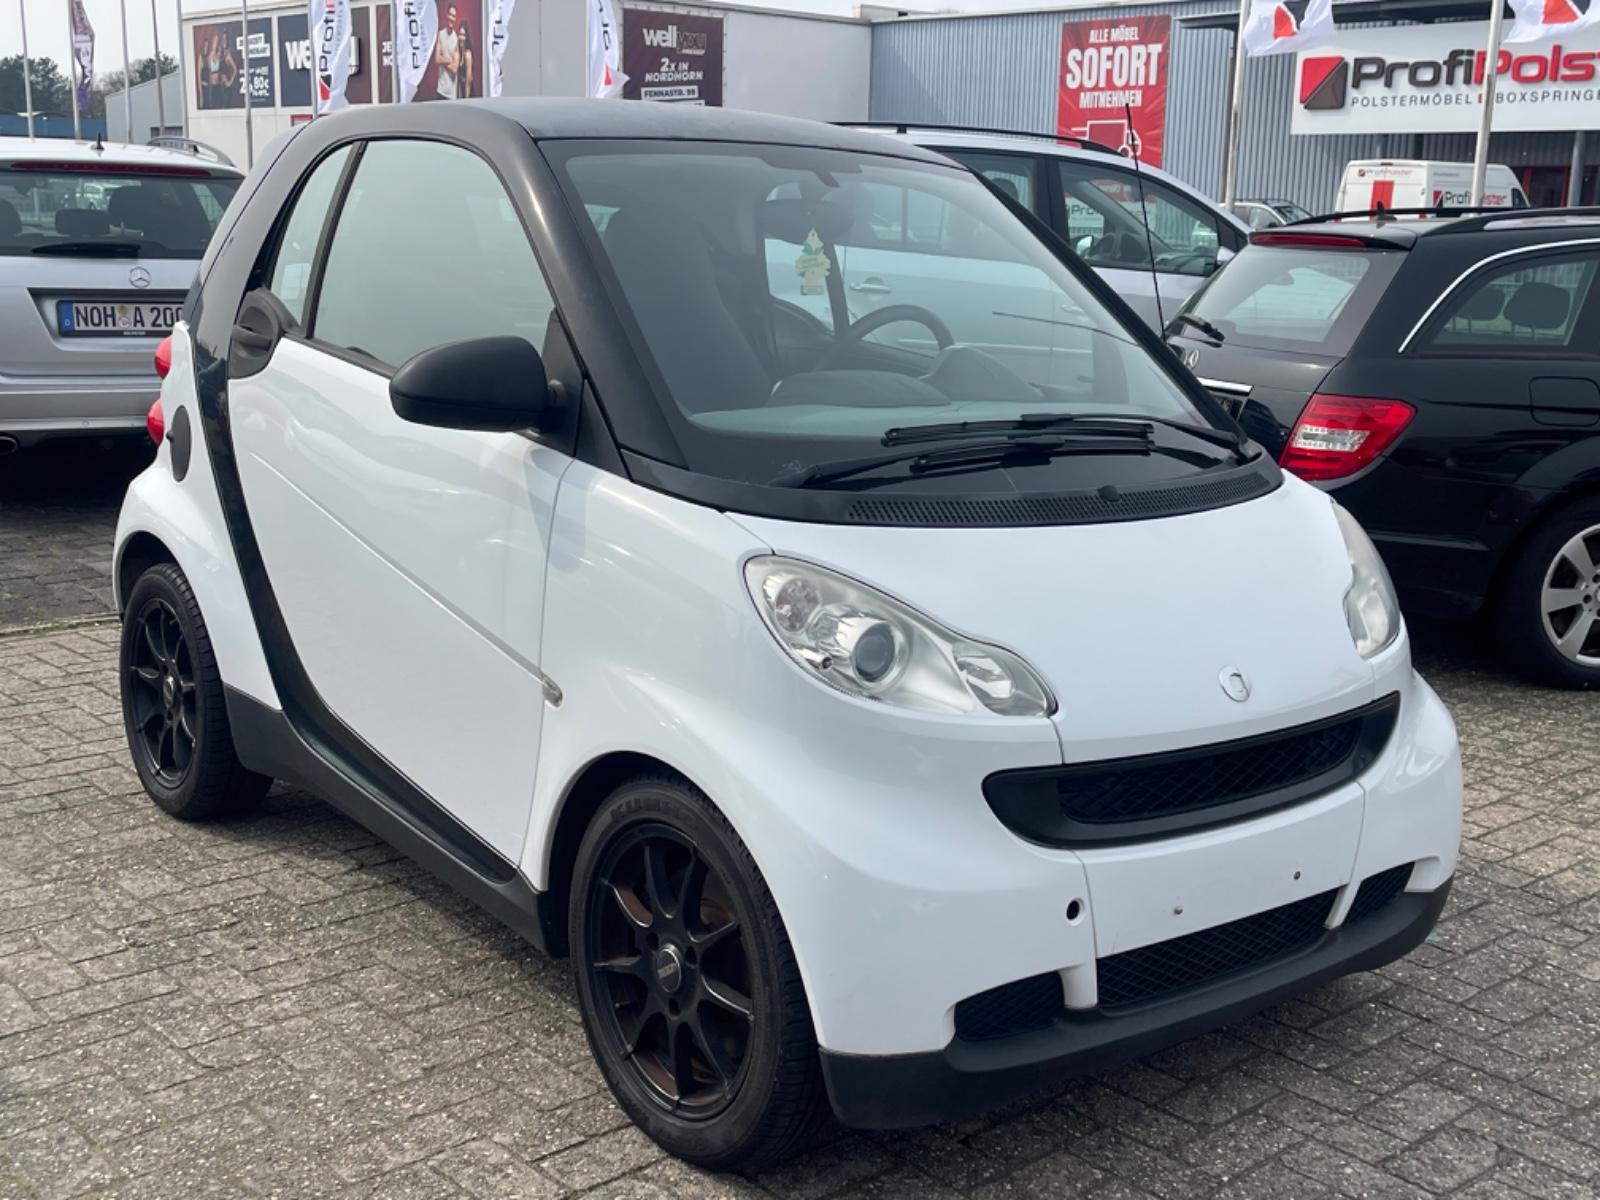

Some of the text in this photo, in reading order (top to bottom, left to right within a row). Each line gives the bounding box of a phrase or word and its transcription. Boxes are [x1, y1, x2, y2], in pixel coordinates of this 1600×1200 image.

[1089, 25, 1139, 43] ALLE MÖBEL
[1066, 43, 1163, 89] SOFORT
[1352, 44, 1600, 88] ProfiPols
[645, 71, 704, 82] NORDHORN
[1079, 89, 1142, 108] MITNEHMEN
[1351, 93, 1472, 108] POLSTERMÖBEL
[75, 305, 117, 328] NOH
[133, 306, 145, 328] A
